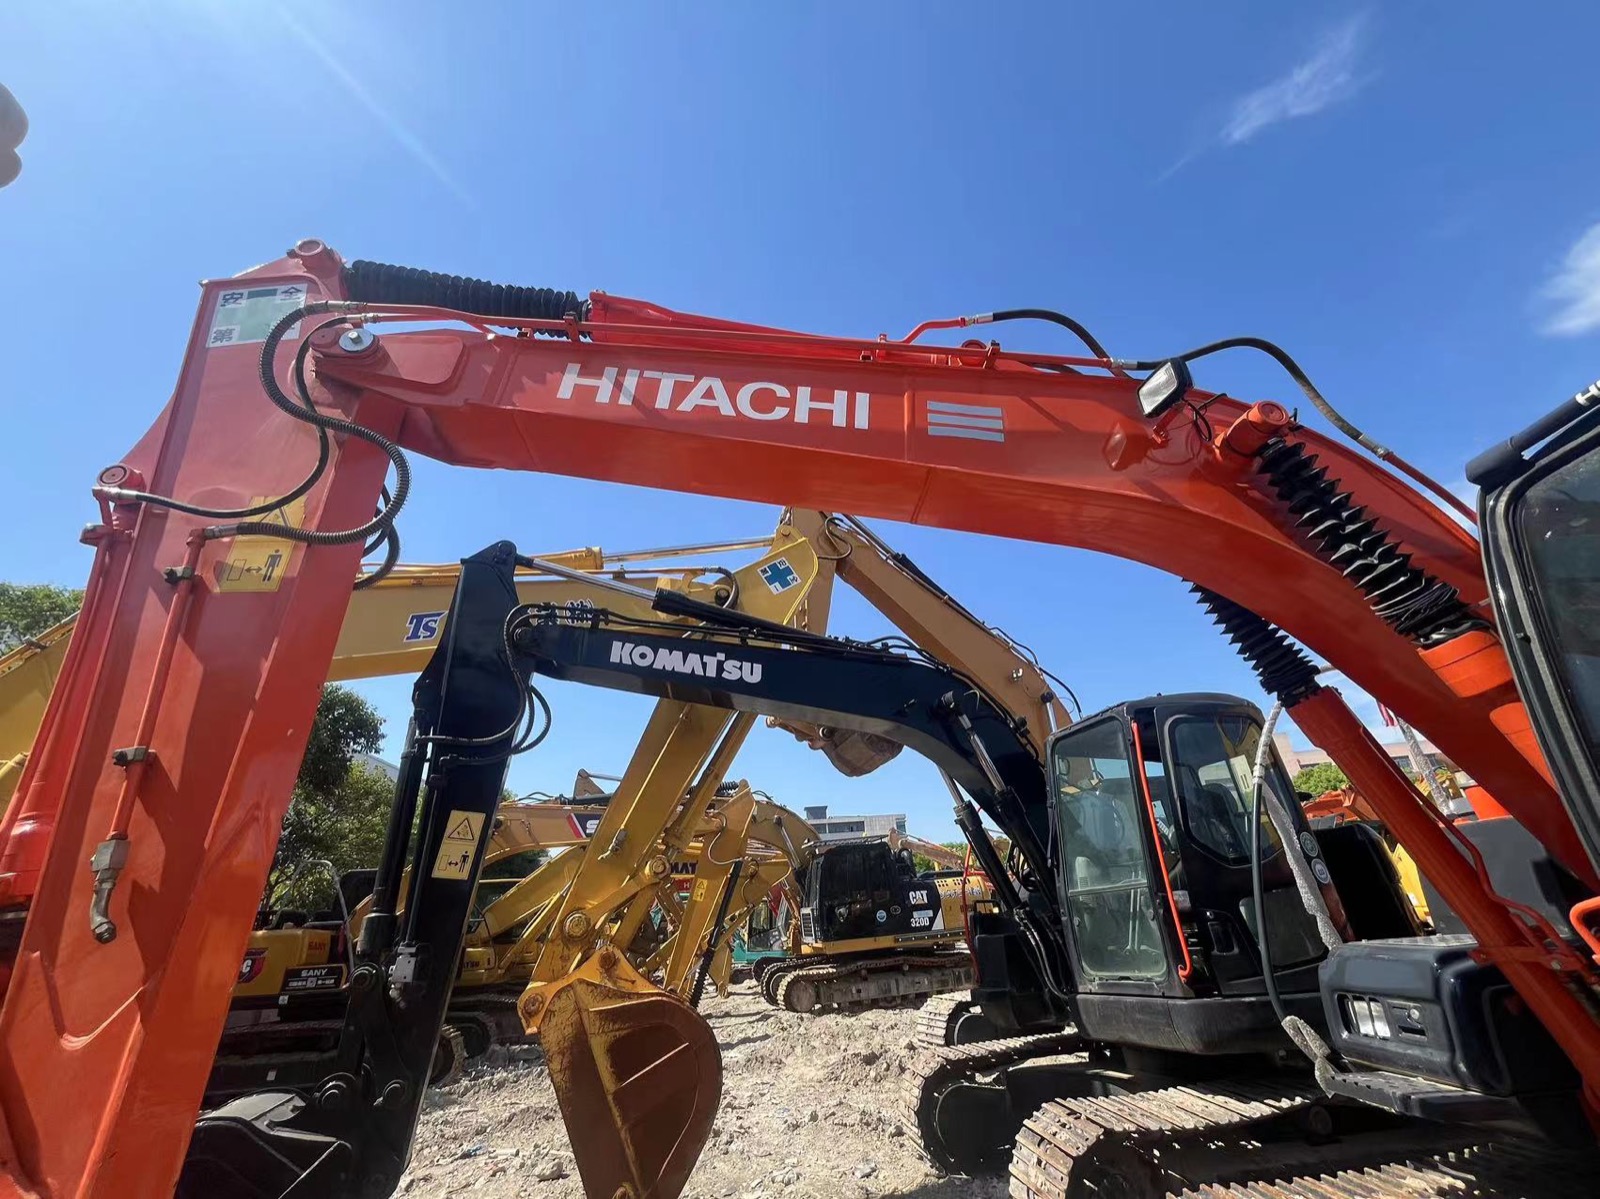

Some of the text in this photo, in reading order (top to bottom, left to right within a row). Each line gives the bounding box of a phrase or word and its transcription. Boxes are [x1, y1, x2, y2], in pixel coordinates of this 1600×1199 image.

[557, 363, 870, 430] HITACHI
[609, 640, 763, 684] KOMATSU
[908, 890, 928, 905] CAT
[910, 917, 930, 928] 320D
[301, 968, 328, 978] SANY
